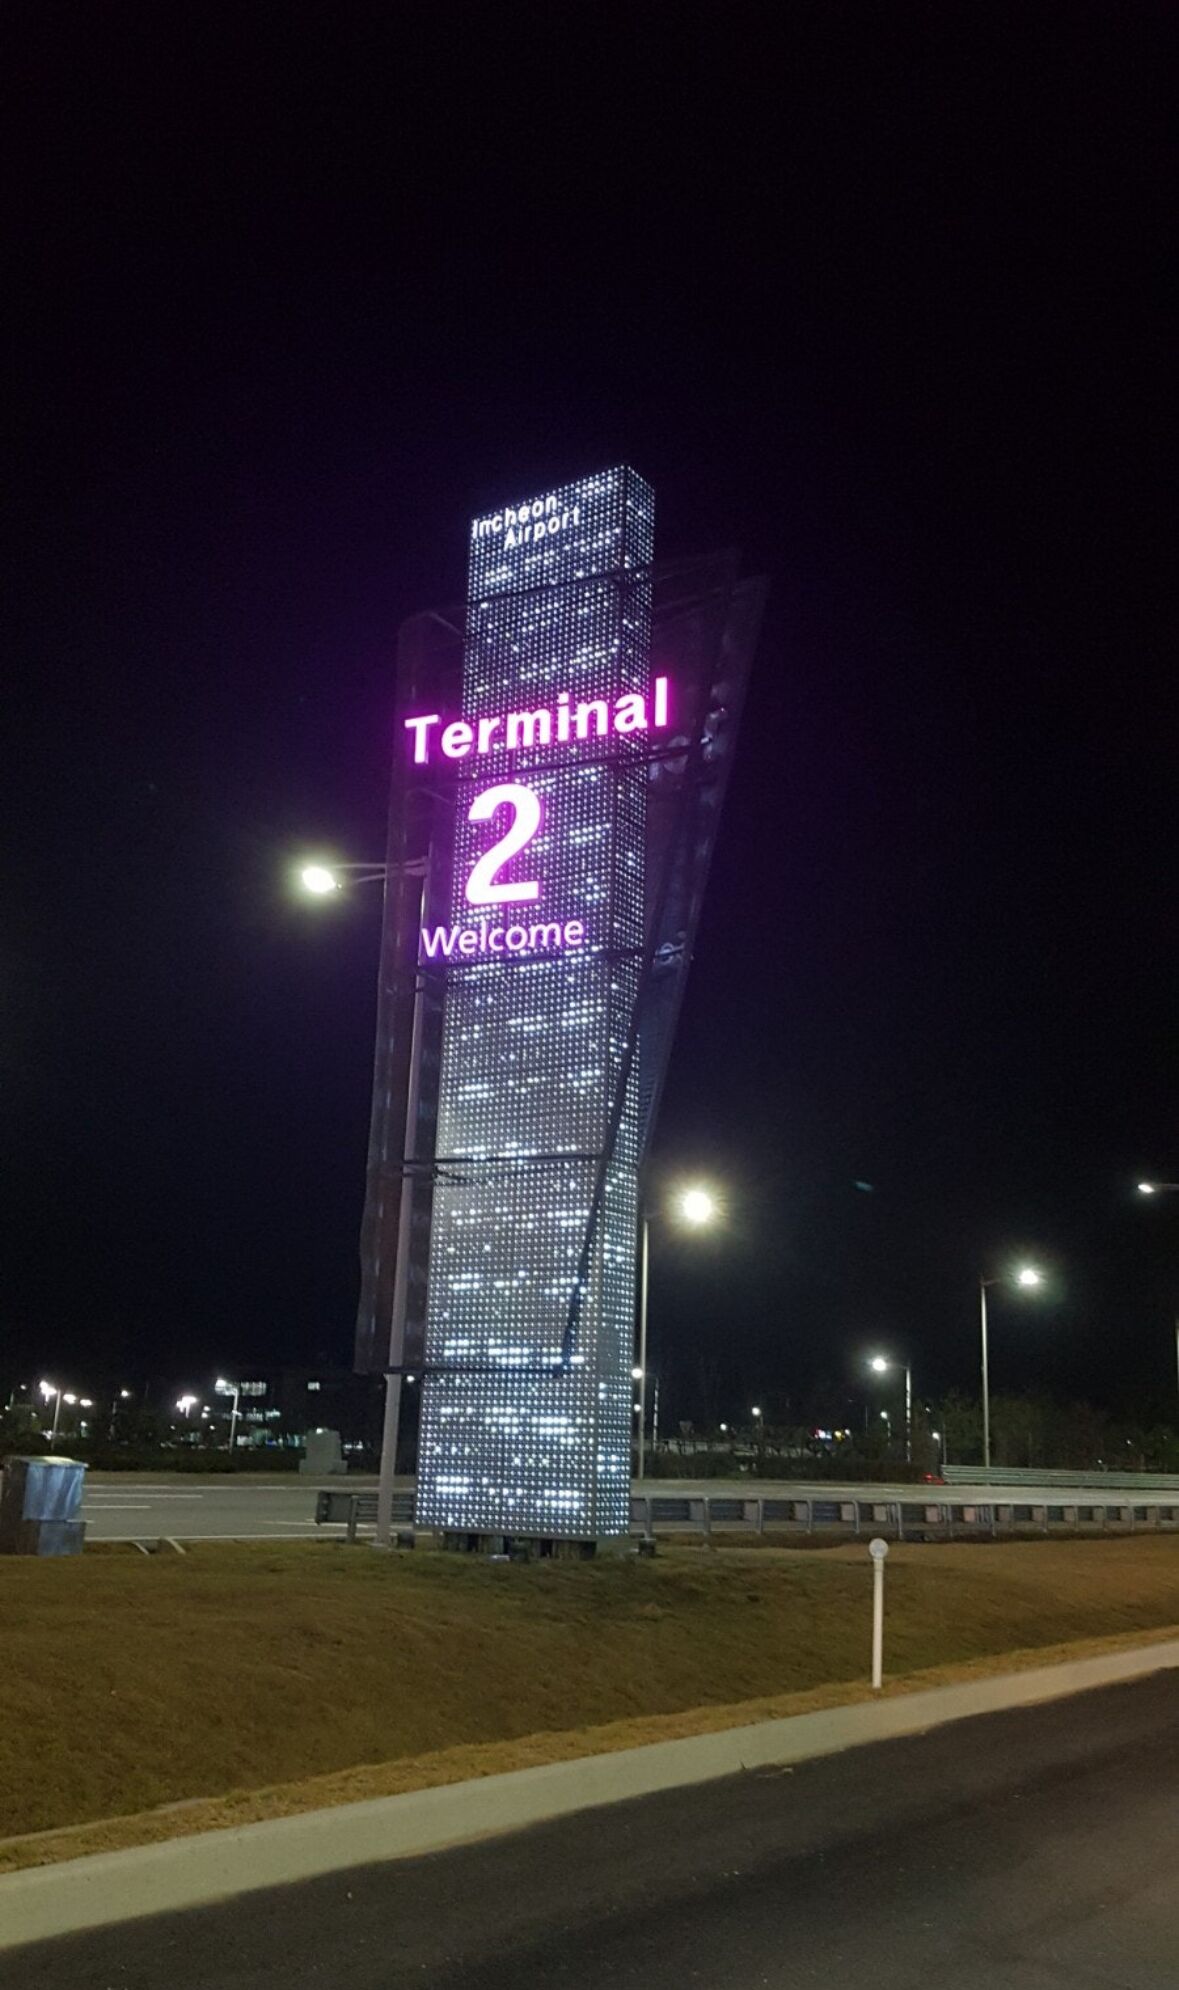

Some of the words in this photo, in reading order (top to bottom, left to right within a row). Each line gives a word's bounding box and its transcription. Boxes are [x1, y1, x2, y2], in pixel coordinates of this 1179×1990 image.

[472, 495, 557, 538] Incheon
[503, 505, 580, 550] Airport
[404, 677, 668, 764] Terminal
[465, 783, 541, 904] 2
[421, 917, 584, 957] Welcome
